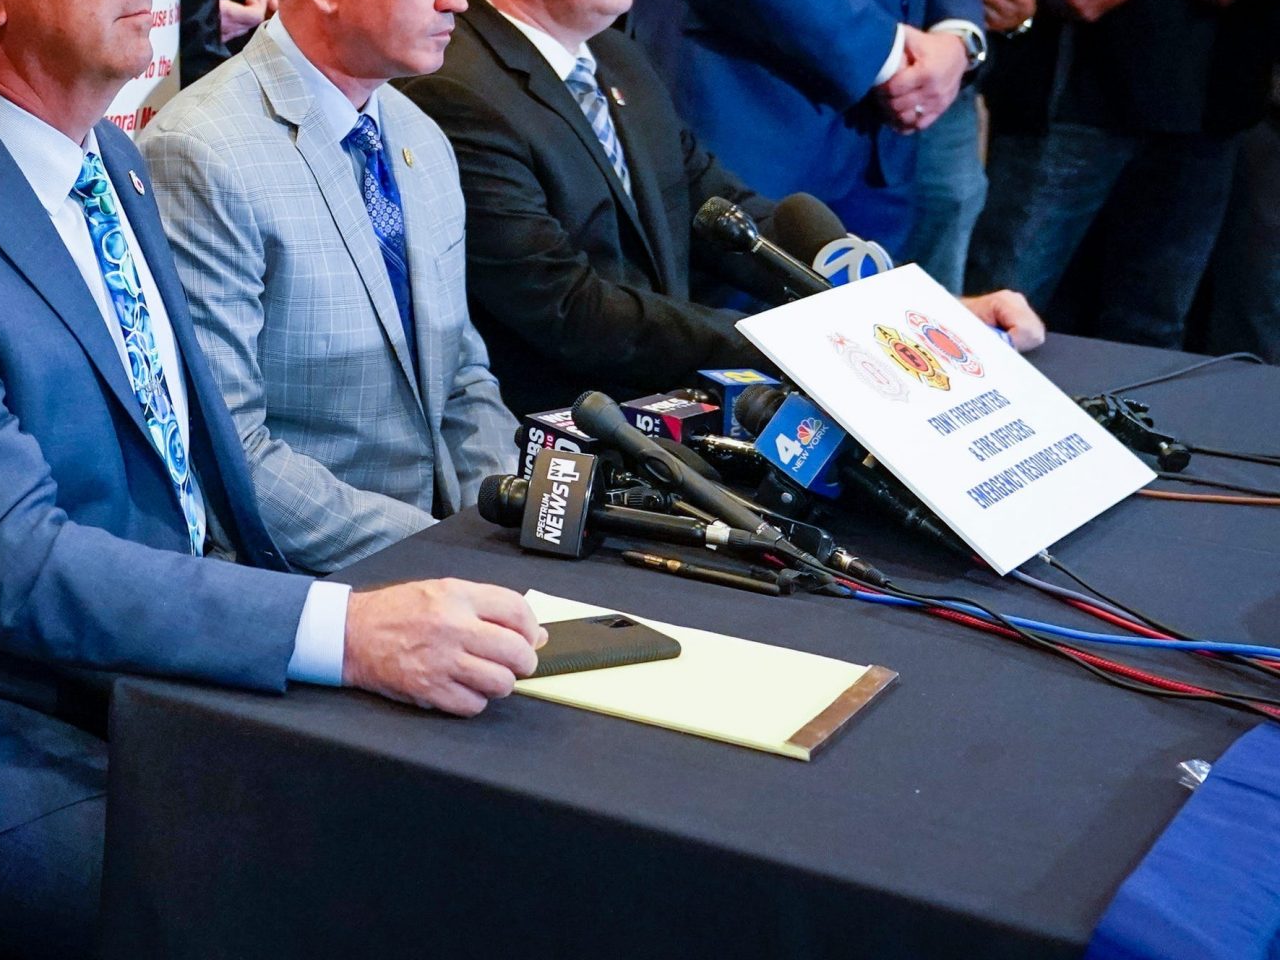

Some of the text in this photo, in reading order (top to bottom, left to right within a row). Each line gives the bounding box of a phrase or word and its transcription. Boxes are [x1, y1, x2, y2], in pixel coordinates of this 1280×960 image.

[927, 389, 1011, 437] FDNY FIREFIGHTERS
[775, 433, 803, 465] 4
[792, 424, 829, 472] NEW YORK
[968, 418, 1036, 462] & FIRE OFFICERS
[550, 461, 561, 477] NY
[966, 433, 1093, 509] EMERGENCY RESOURCE CENTER
[536, 493, 551, 539] SPECTRUM
[543, 482, 570, 545] NEWS
